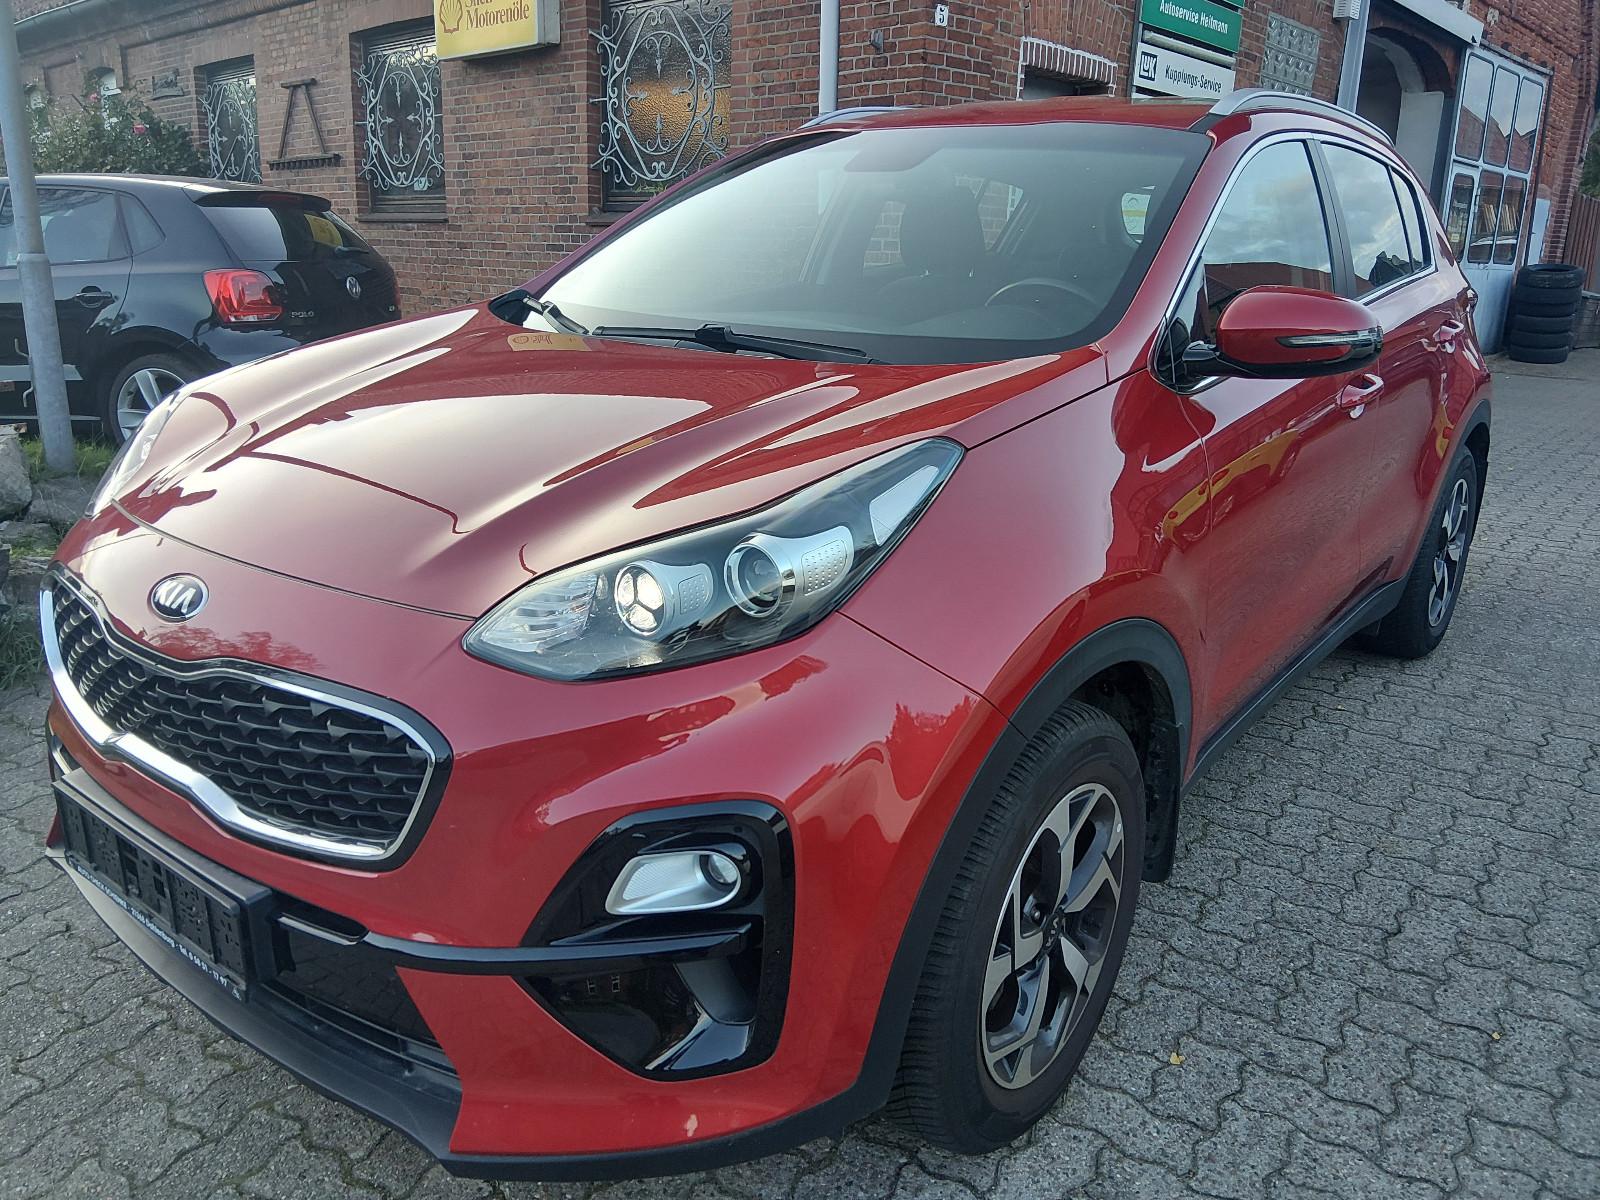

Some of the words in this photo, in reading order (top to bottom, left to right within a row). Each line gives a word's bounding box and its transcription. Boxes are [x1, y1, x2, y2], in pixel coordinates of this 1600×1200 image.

[466, 0, 530, 30] Motorenöle
[1160, 0, 1199, 24] Autoservice
[1200, 12, 1229, 34] Heitmann
[1165, 64, 1222, 93] Kupplungs-Service
[154, 580, 196, 613] KIA
